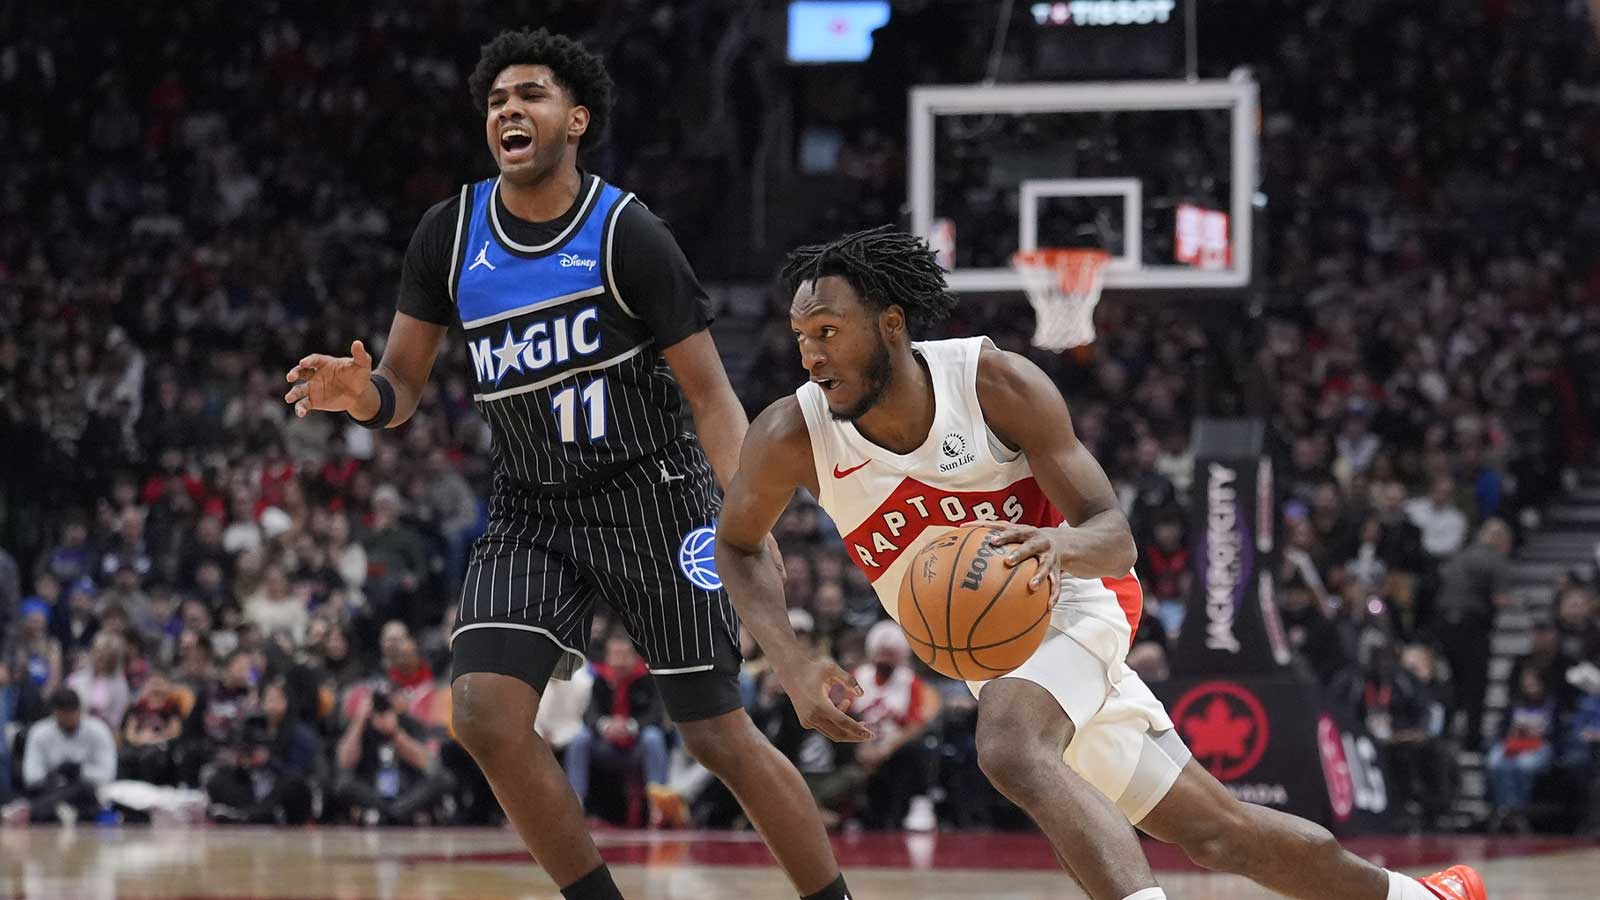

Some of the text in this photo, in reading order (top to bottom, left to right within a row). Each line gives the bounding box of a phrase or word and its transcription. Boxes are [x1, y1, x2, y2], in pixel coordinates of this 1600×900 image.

[1071, 0, 1176, 26] TISSOT
[558, 253, 596, 271] Disney
[552, 376, 606, 444] 11
[940, 453, 976, 472] Sun Life
[854, 495, 1024, 568] RAPTORS
